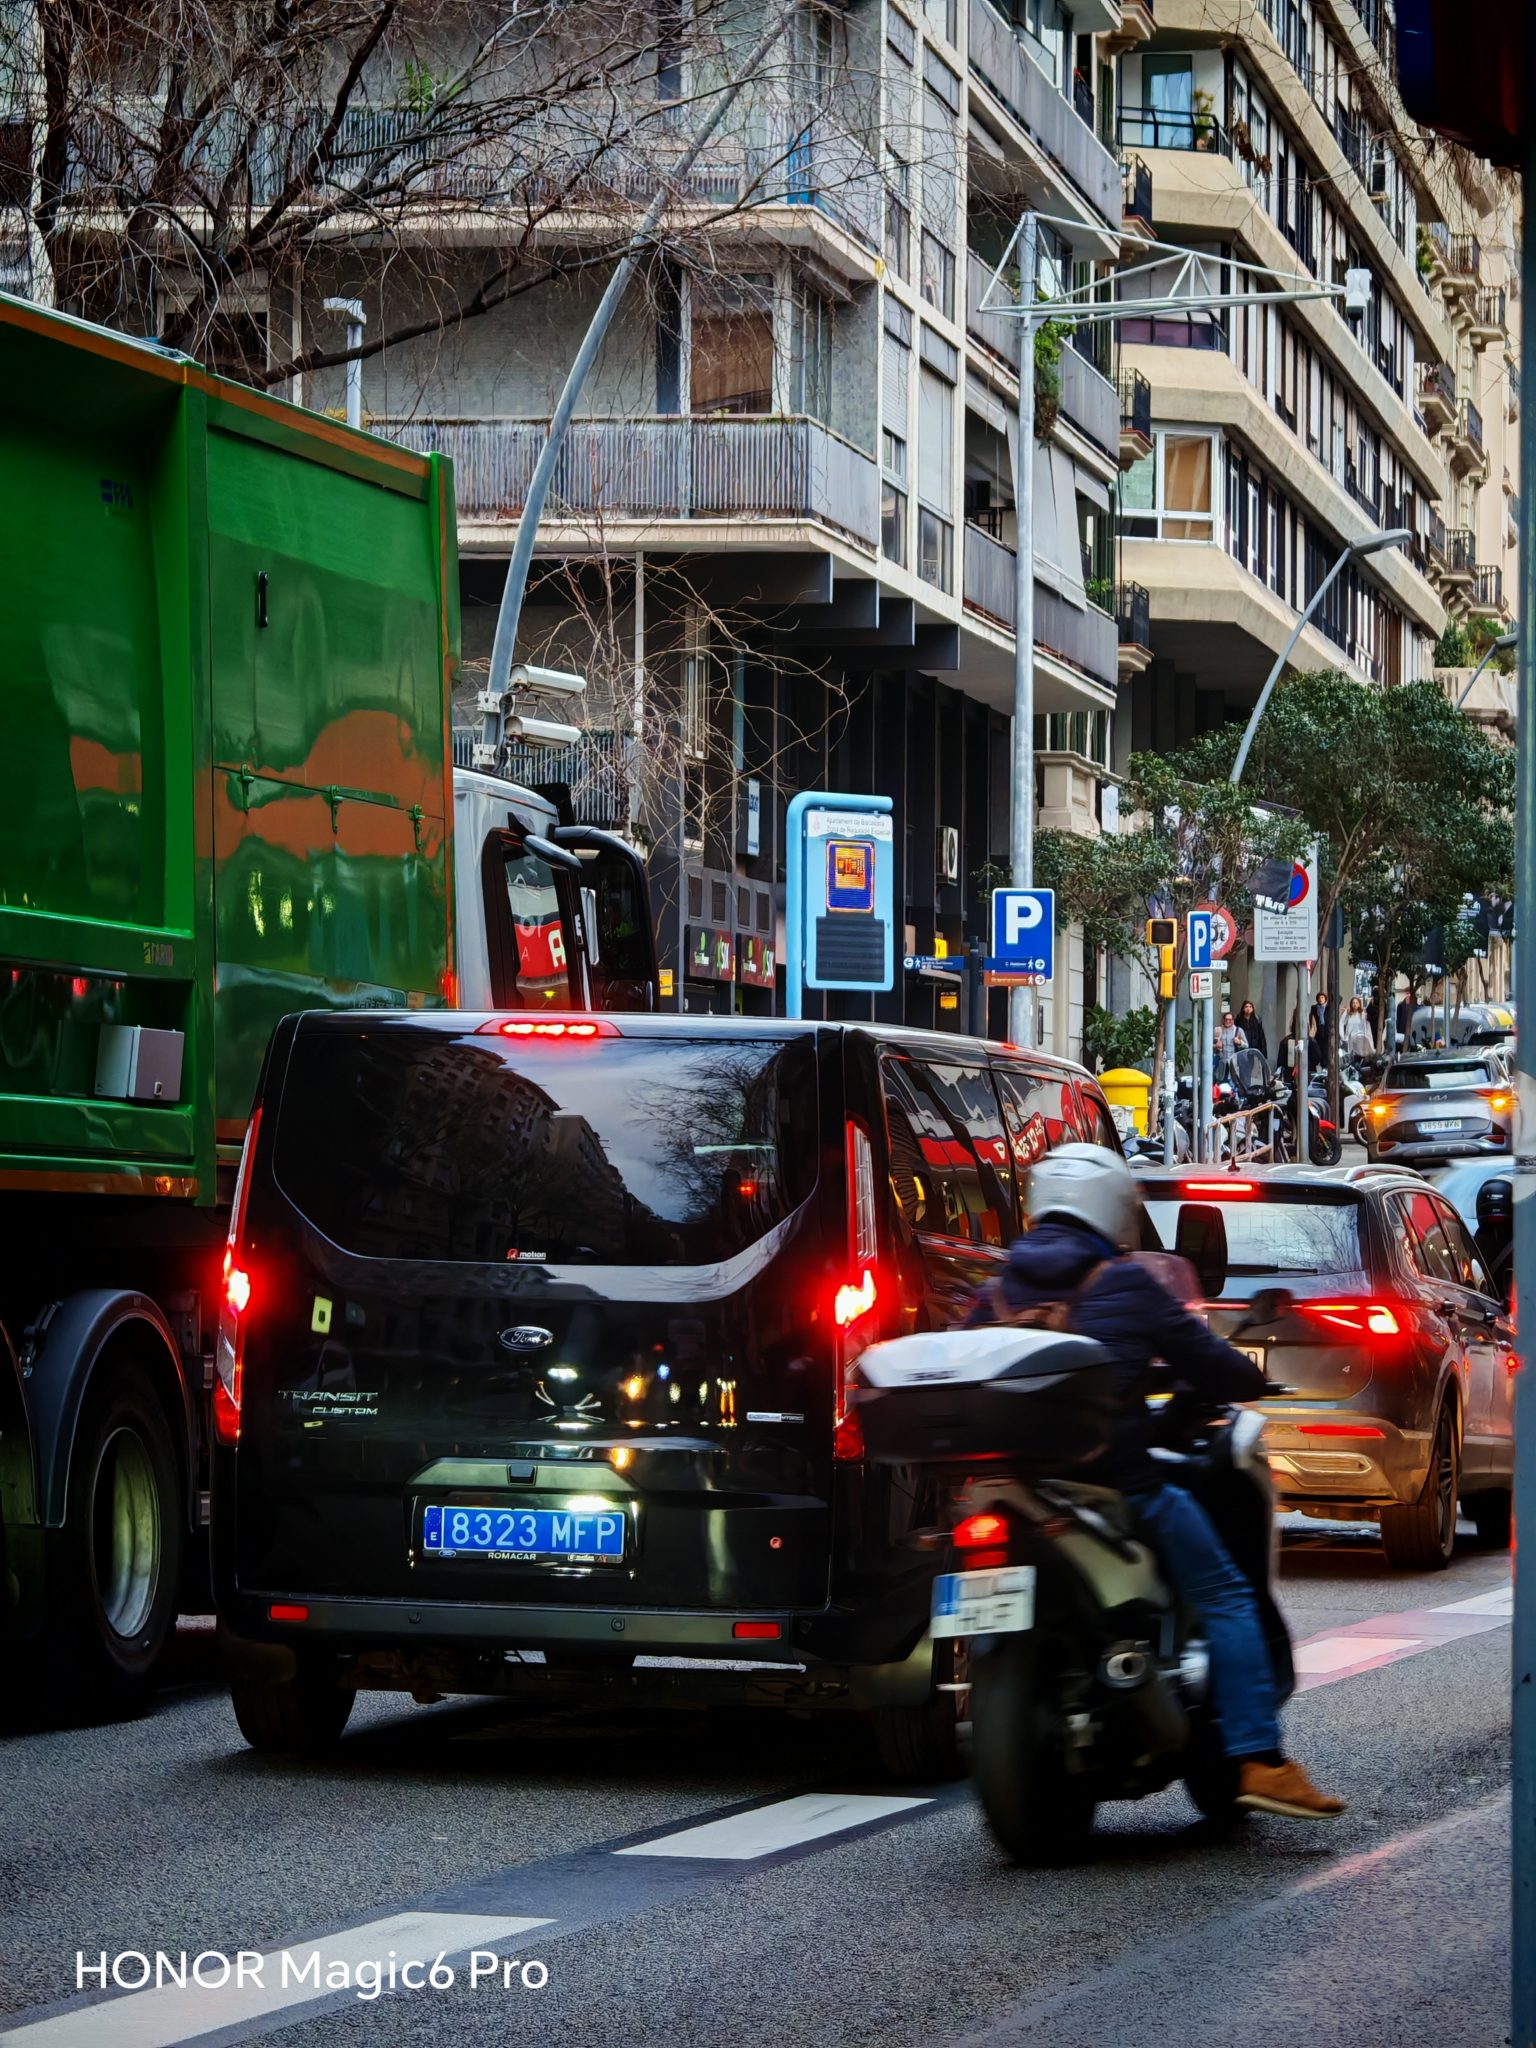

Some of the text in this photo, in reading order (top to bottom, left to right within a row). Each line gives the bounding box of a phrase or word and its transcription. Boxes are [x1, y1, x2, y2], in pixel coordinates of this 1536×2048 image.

[1005, 895, 1043, 945] P
[1194, 920, 1207, 962] P
[519, 1251, 546, 1259] motion
[278, 1390, 379, 1402] TRANSIT
[312, 1406, 379, 1416] CUSTOM
[430, 1531, 438, 1541] E
[451, 1512, 616, 1550] 8323 MFP
[487, 1552, 537, 1561] ROMACAR
